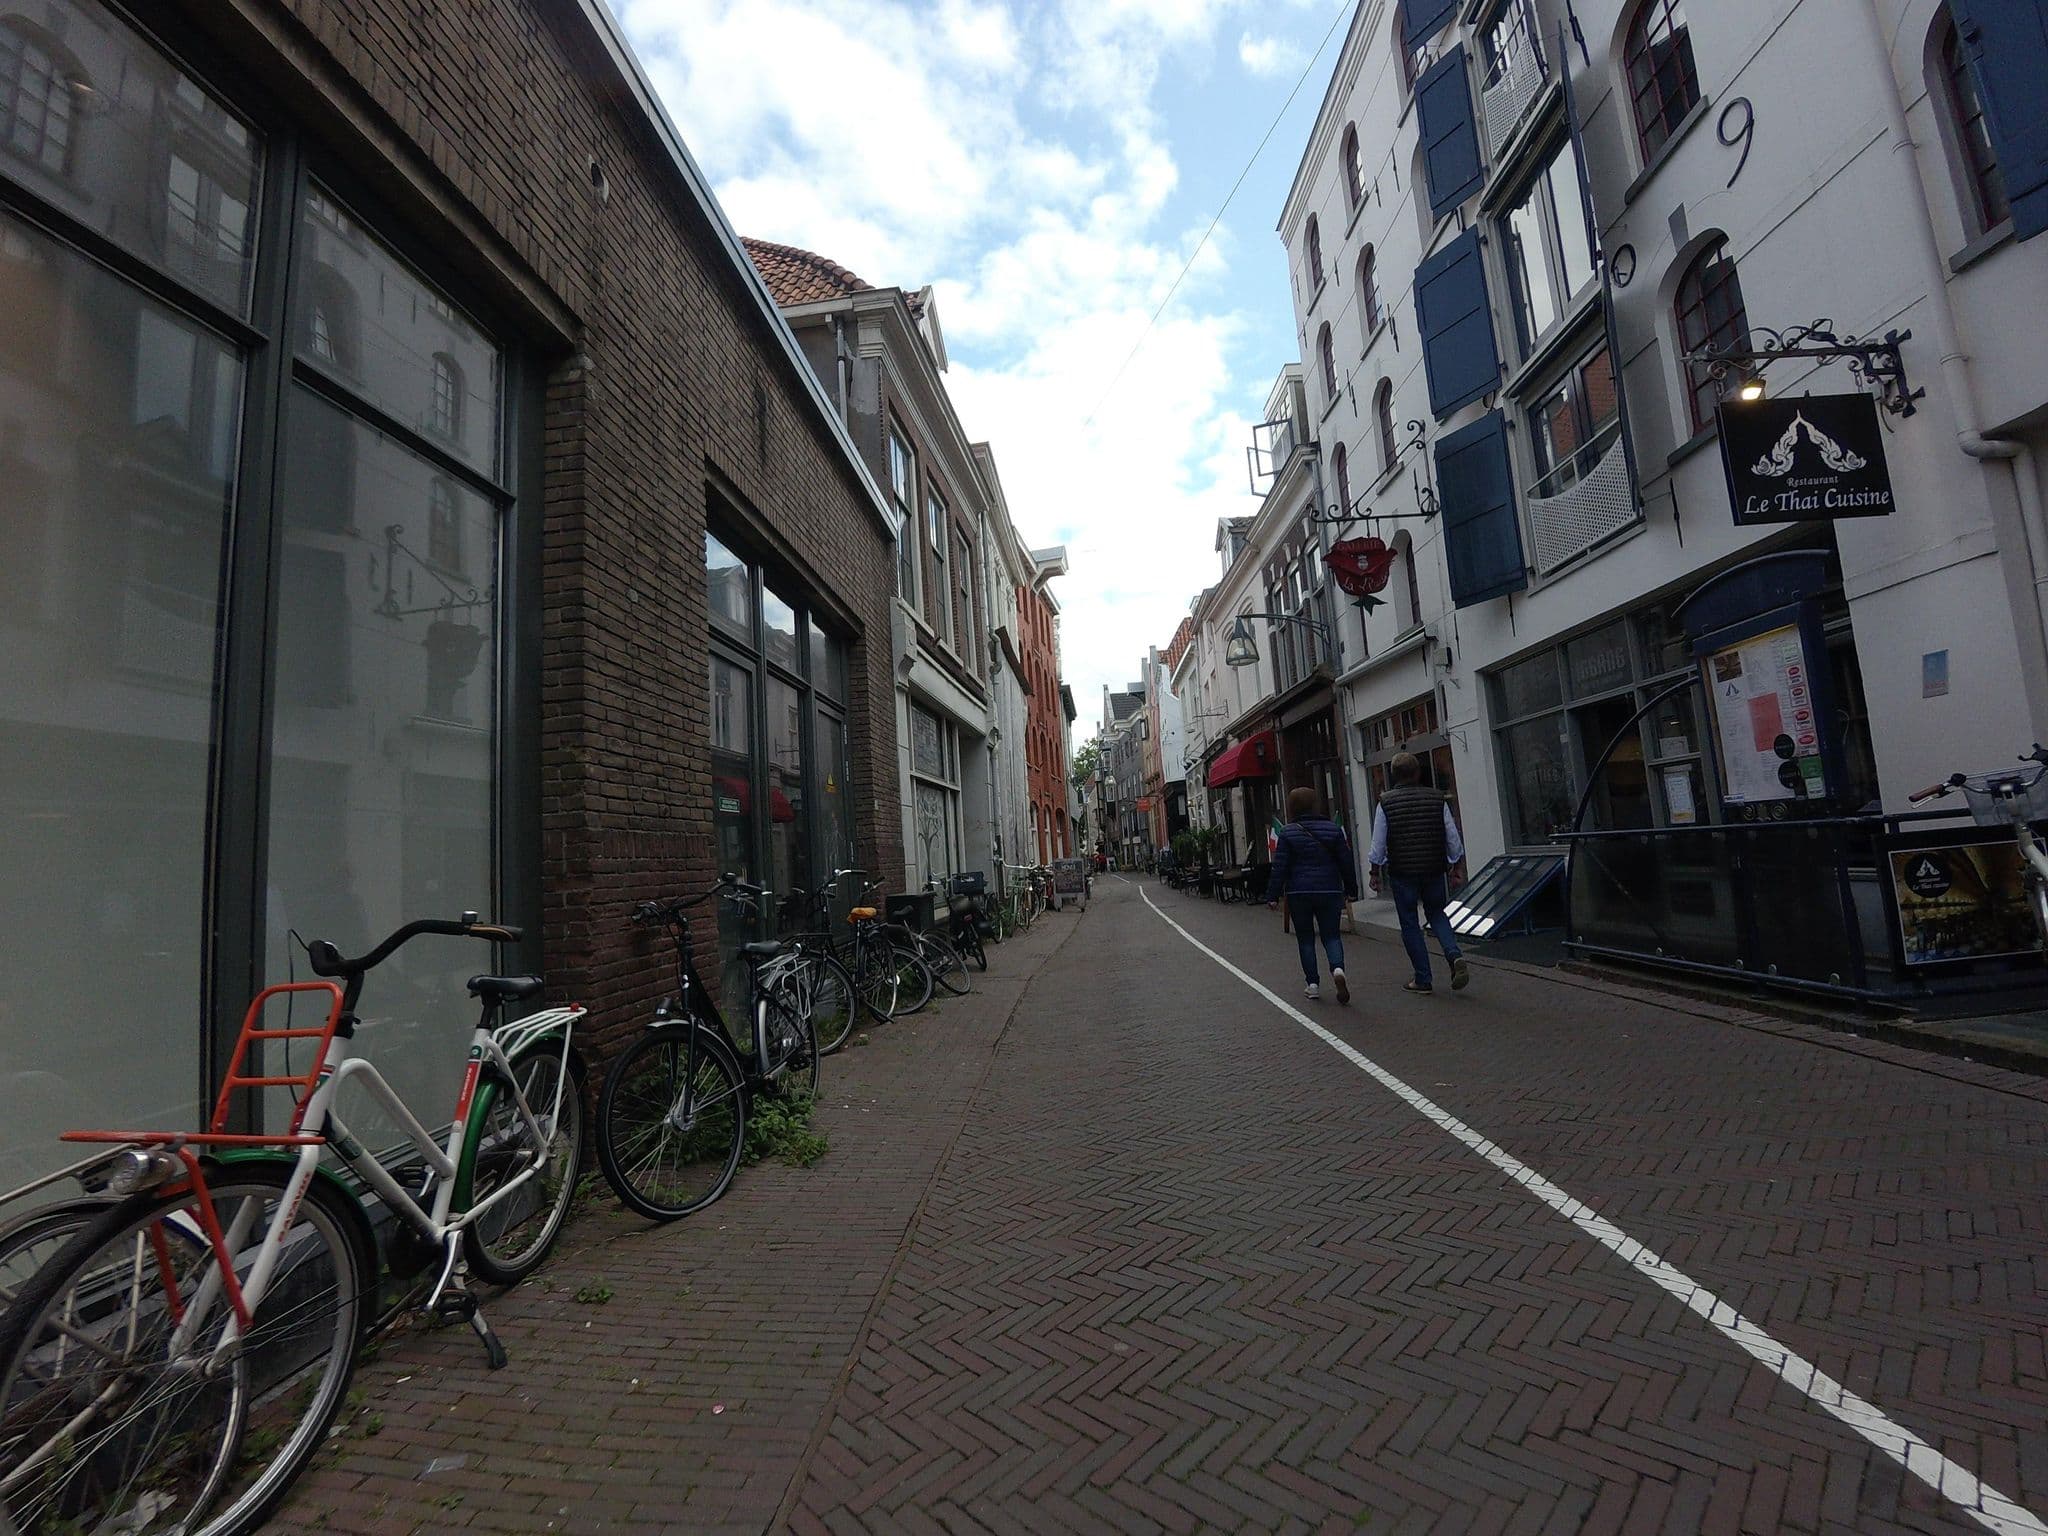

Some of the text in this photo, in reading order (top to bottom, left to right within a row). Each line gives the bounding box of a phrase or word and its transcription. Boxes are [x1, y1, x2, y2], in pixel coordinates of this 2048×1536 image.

[1716, 96, 1755, 189] 9
[1786, 475, 1839, 487] Restaurant
[1744, 487, 1890, 514] Le Thai Cuisine
